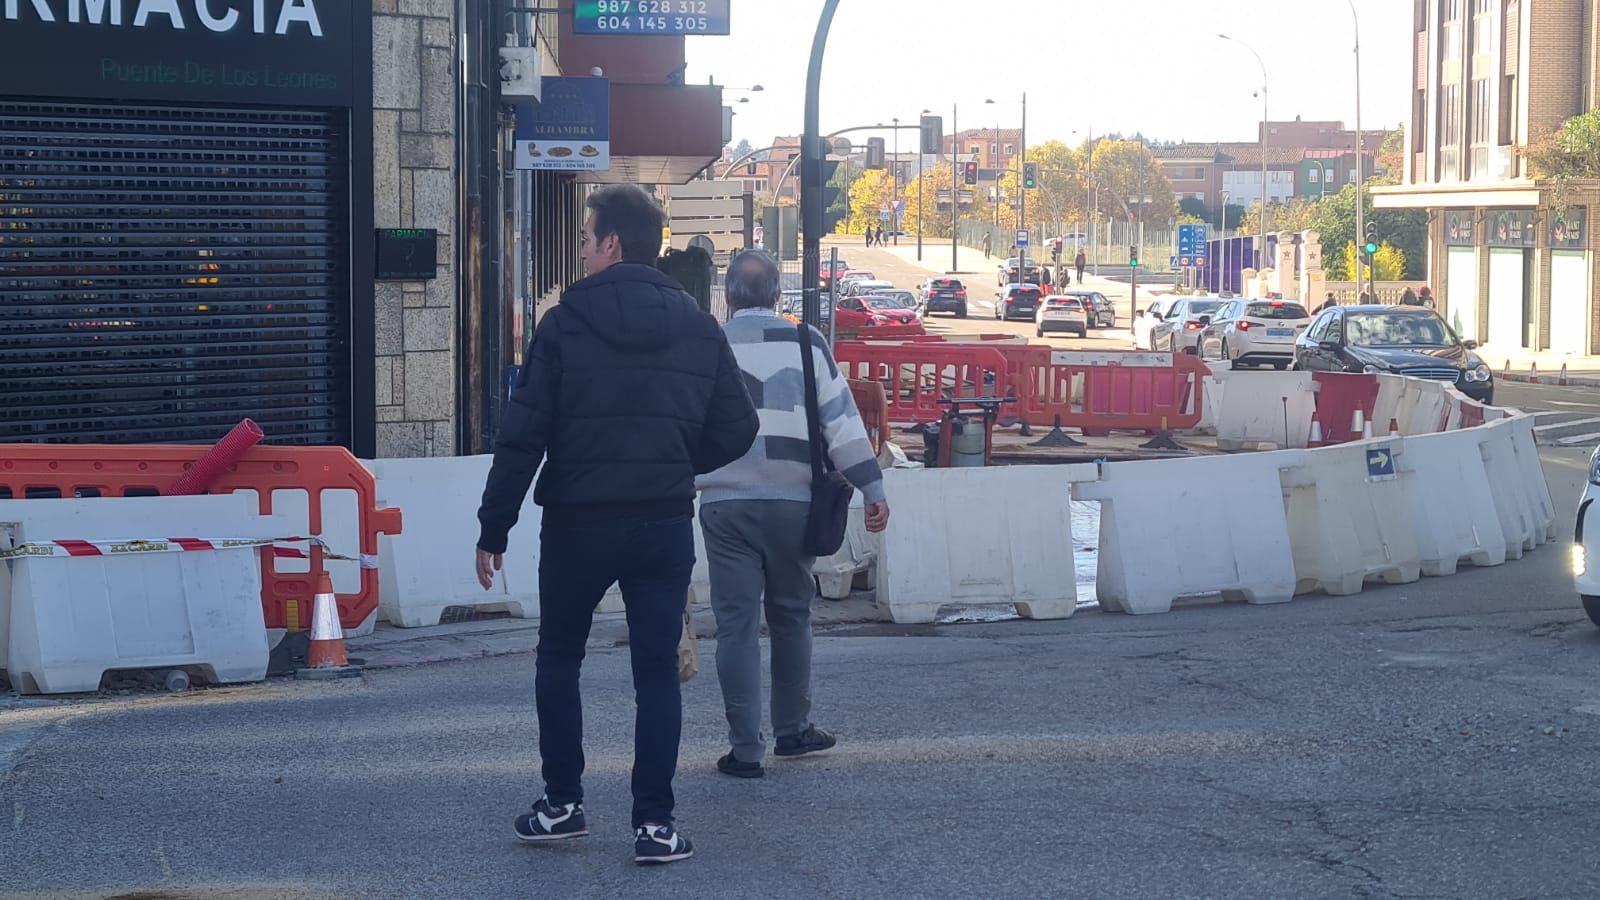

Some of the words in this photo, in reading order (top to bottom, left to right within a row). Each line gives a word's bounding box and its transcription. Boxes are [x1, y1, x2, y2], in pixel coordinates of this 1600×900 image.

[597, 0, 630, 14] 987
[638, 0, 671, 14] 628
[679, 0, 707, 14] 312
[597, 17, 631, 30] 604
[638, 17, 667, 30] 145
[674, 17, 708, 30] 305
[101, 57, 177, 83] Puente
[184, 61, 215, 84] De
[222, 63, 257, 87] Los
[264, 65, 337, 89] Leones
[385, 229, 434, 239] FARMACI
